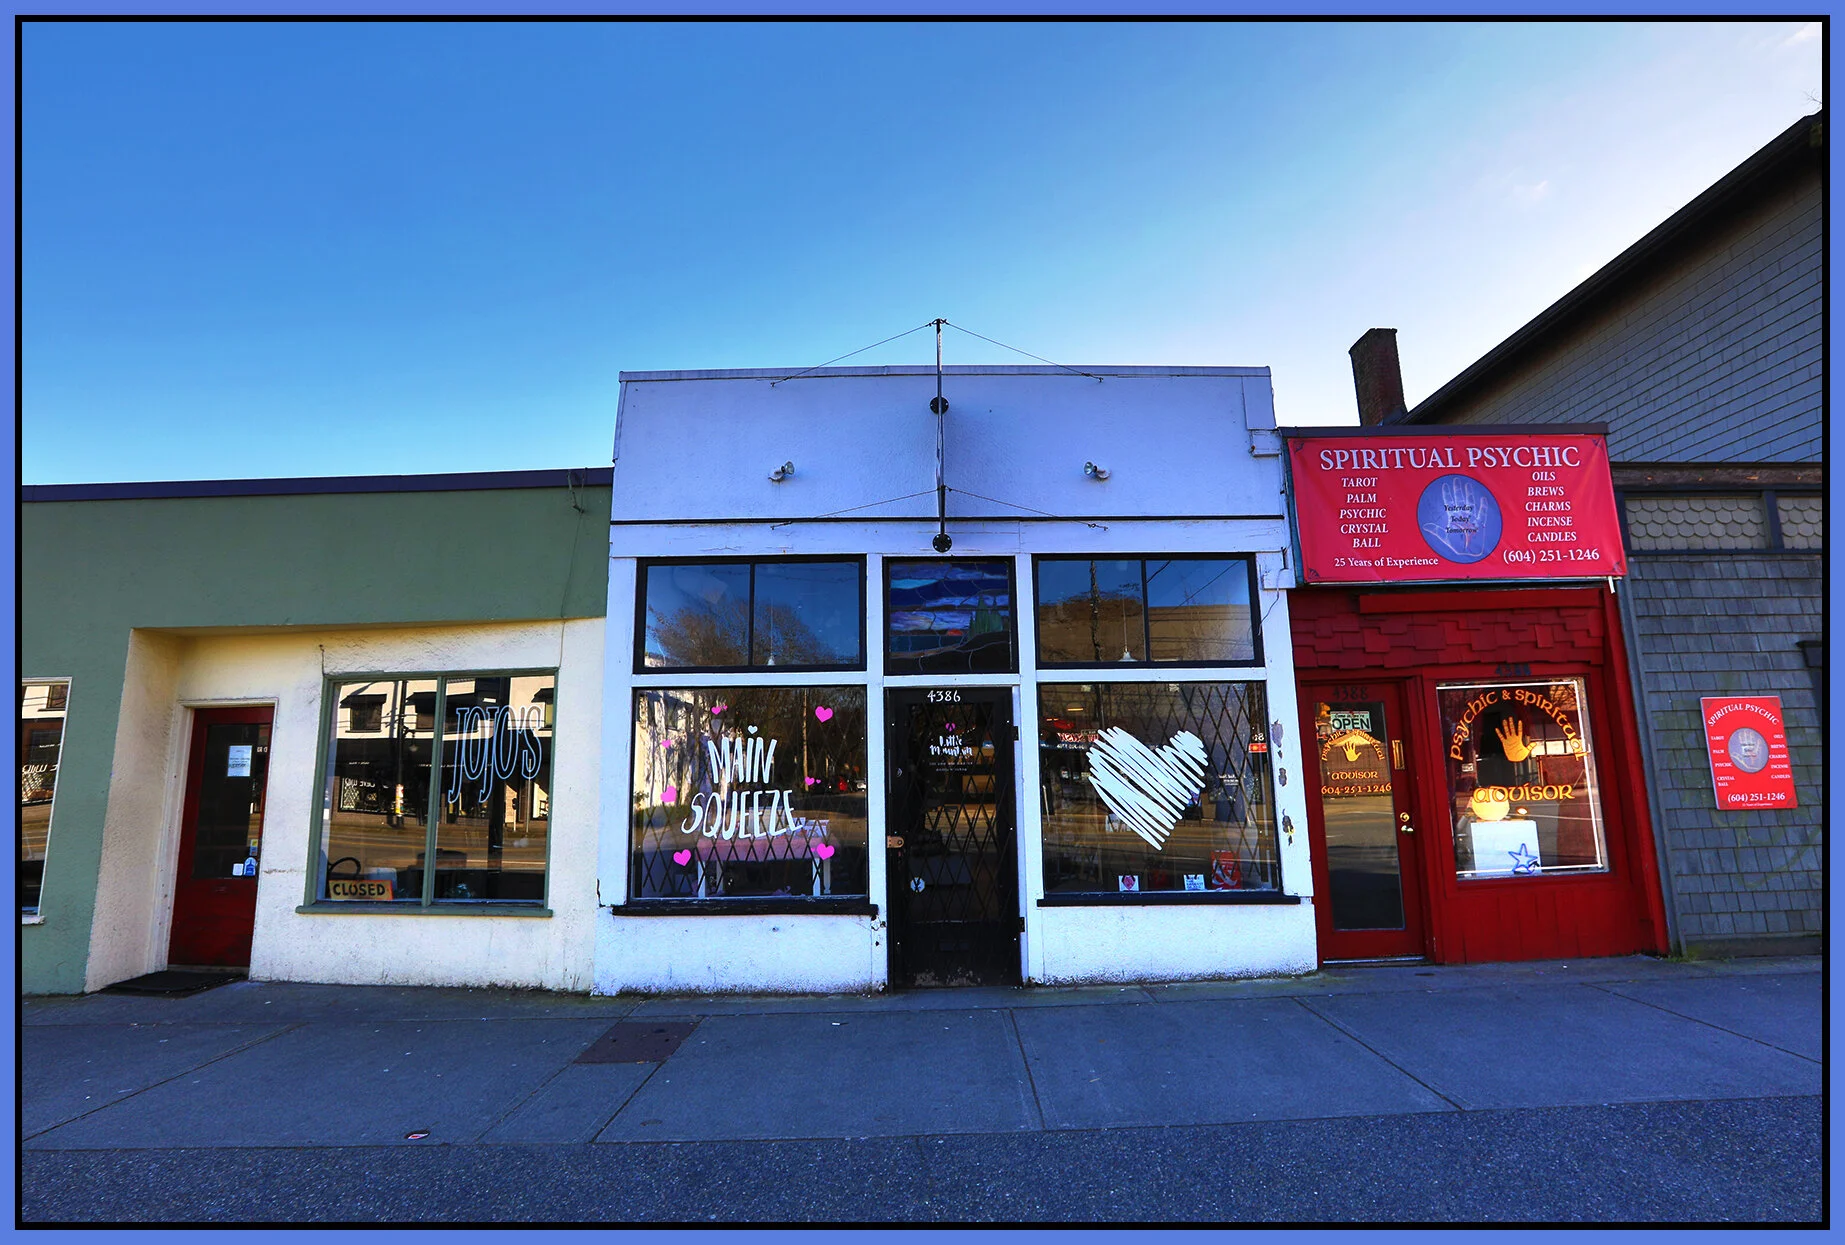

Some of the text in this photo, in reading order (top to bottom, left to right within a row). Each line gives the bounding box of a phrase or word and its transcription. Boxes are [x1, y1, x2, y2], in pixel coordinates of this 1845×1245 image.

[1319, 446, 1581, 470] SPIRITUAL PSYCHIC
[1532, 471, 1556, 482] OILS
[1341, 477, 1378, 488] TAROT
[1527, 486, 1565, 497] BREWS
[1346, 493, 1377, 503] PALM
[1443, 504, 1474, 513] Yesterday
[1525, 501, 1571, 512] CHARMS
[1339, 508, 1387, 519] PSYCHIC
[1527, 516, 1573, 527] INCENSE
[1340, 523, 1389, 534] CRYSTAL
[1352, 537, 1382, 548] BALL
[1527, 531, 1577, 543] CANDLES
[1334, 556, 1439, 568] 25 Years of Experience
[1503, 548, 1600, 565] (604) 251-1246
[927, 689, 961, 703] 4386
[1502, 690, 1511, 701] &
[1707, 703, 1780, 727] SPIRITUAL PSYCHIC
[1332, 718, 1371, 730] OPEN
[447, 705, 542, 804] JOJO'S
[707, 737, 778, 784] MAIN
[1321, 782, 1392, 795] 604-251-1246
[1727, 792, 1786, 803] (604) 251-1246
[681, 789, 804, 841] SQUEEZE
[332, 883, 386, 897] CLOSED
